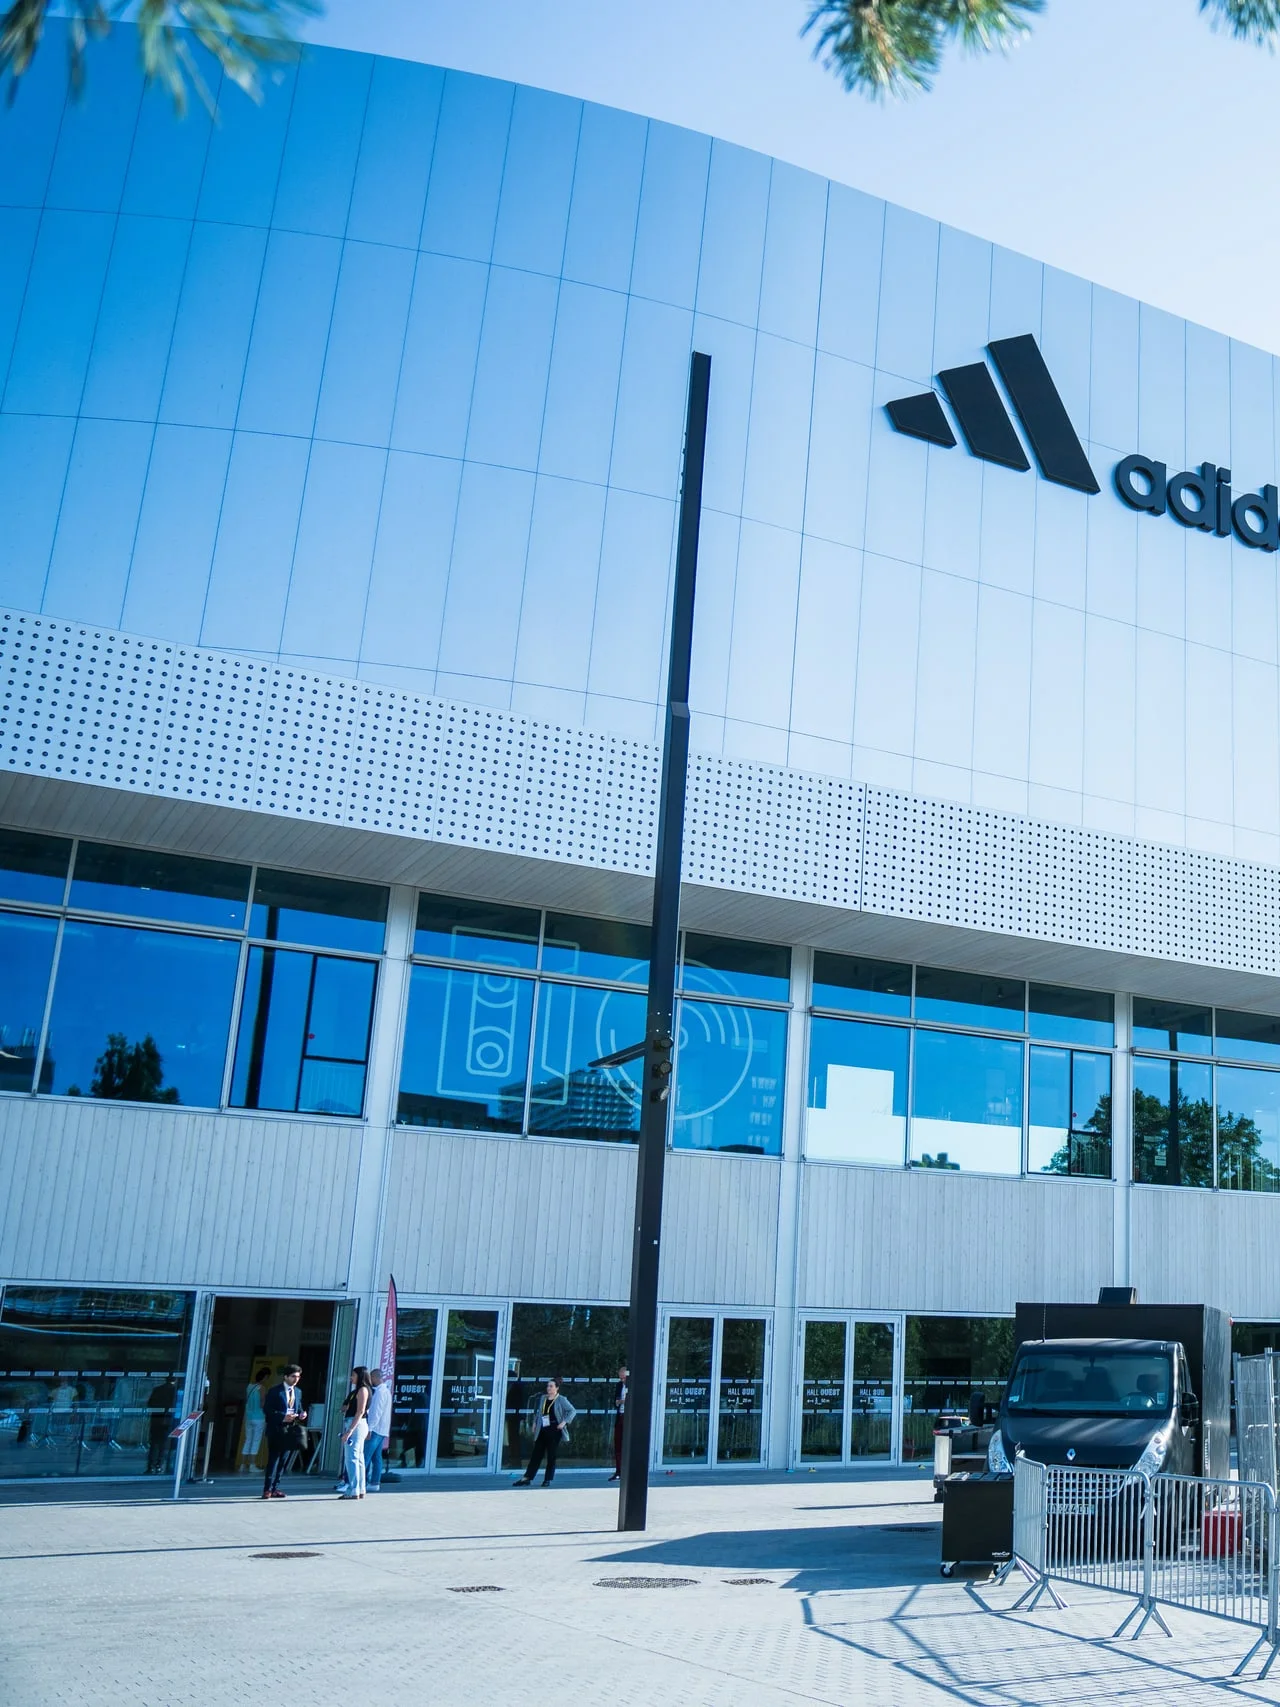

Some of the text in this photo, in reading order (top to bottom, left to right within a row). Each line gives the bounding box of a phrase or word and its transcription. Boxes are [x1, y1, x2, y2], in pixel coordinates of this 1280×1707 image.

[401, 1385, 426, 1393] OUEST
[451, 1385, 466, 1393] HALL
[670, 1387, 706, 1395] HALL OUEST
[807, 1388, 840, 1396] HALL OUEST
[860, 1388, 885, 1396] HALL SUD
